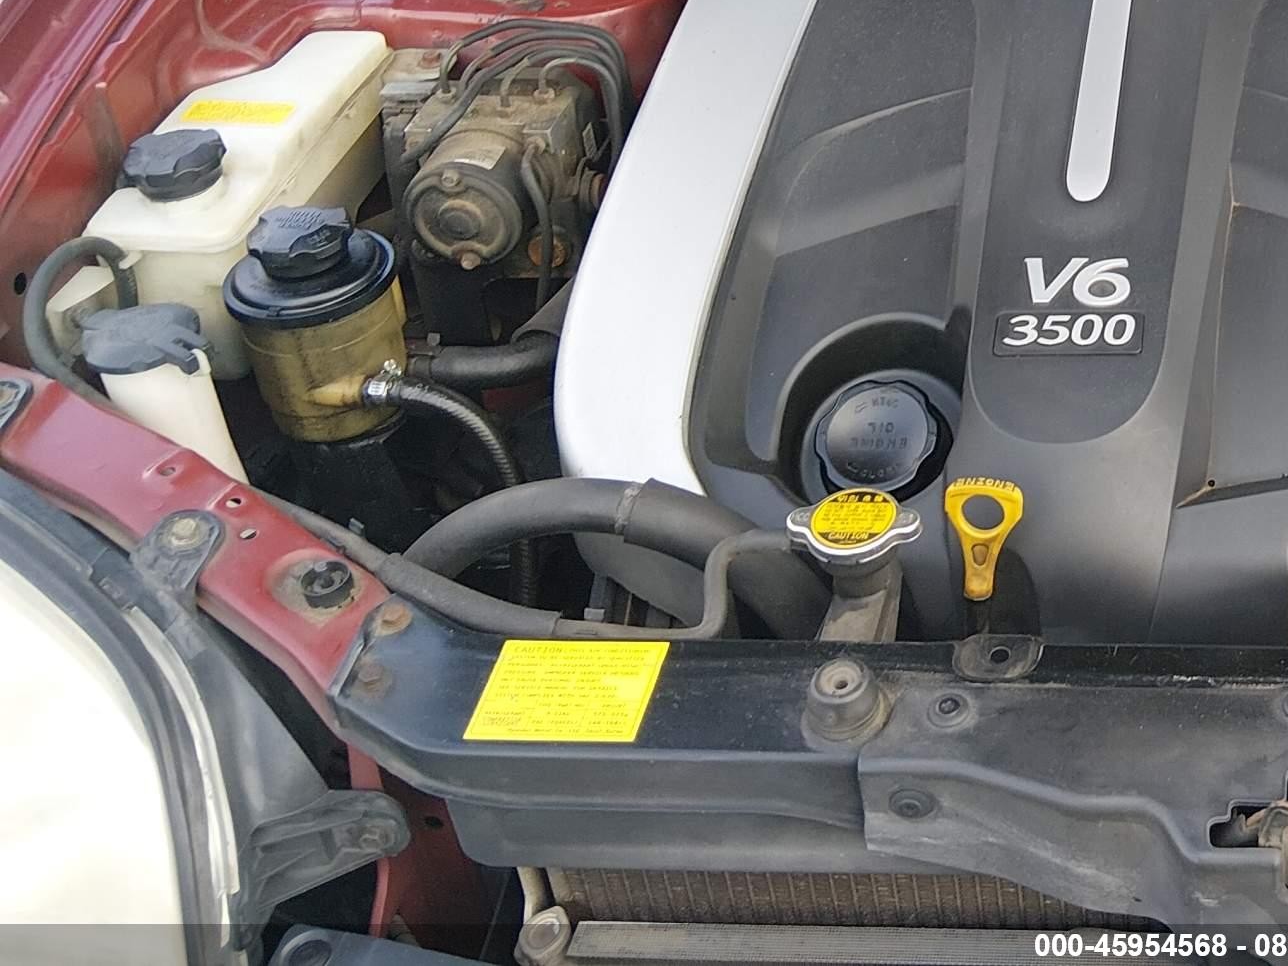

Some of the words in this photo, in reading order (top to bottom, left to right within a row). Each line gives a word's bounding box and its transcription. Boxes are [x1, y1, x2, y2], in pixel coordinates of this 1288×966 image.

[1024, 257, 1131, 308] V6
[1002, 314, 1136, 346] 3500
[827, 531, 870, 540] CAUTION
